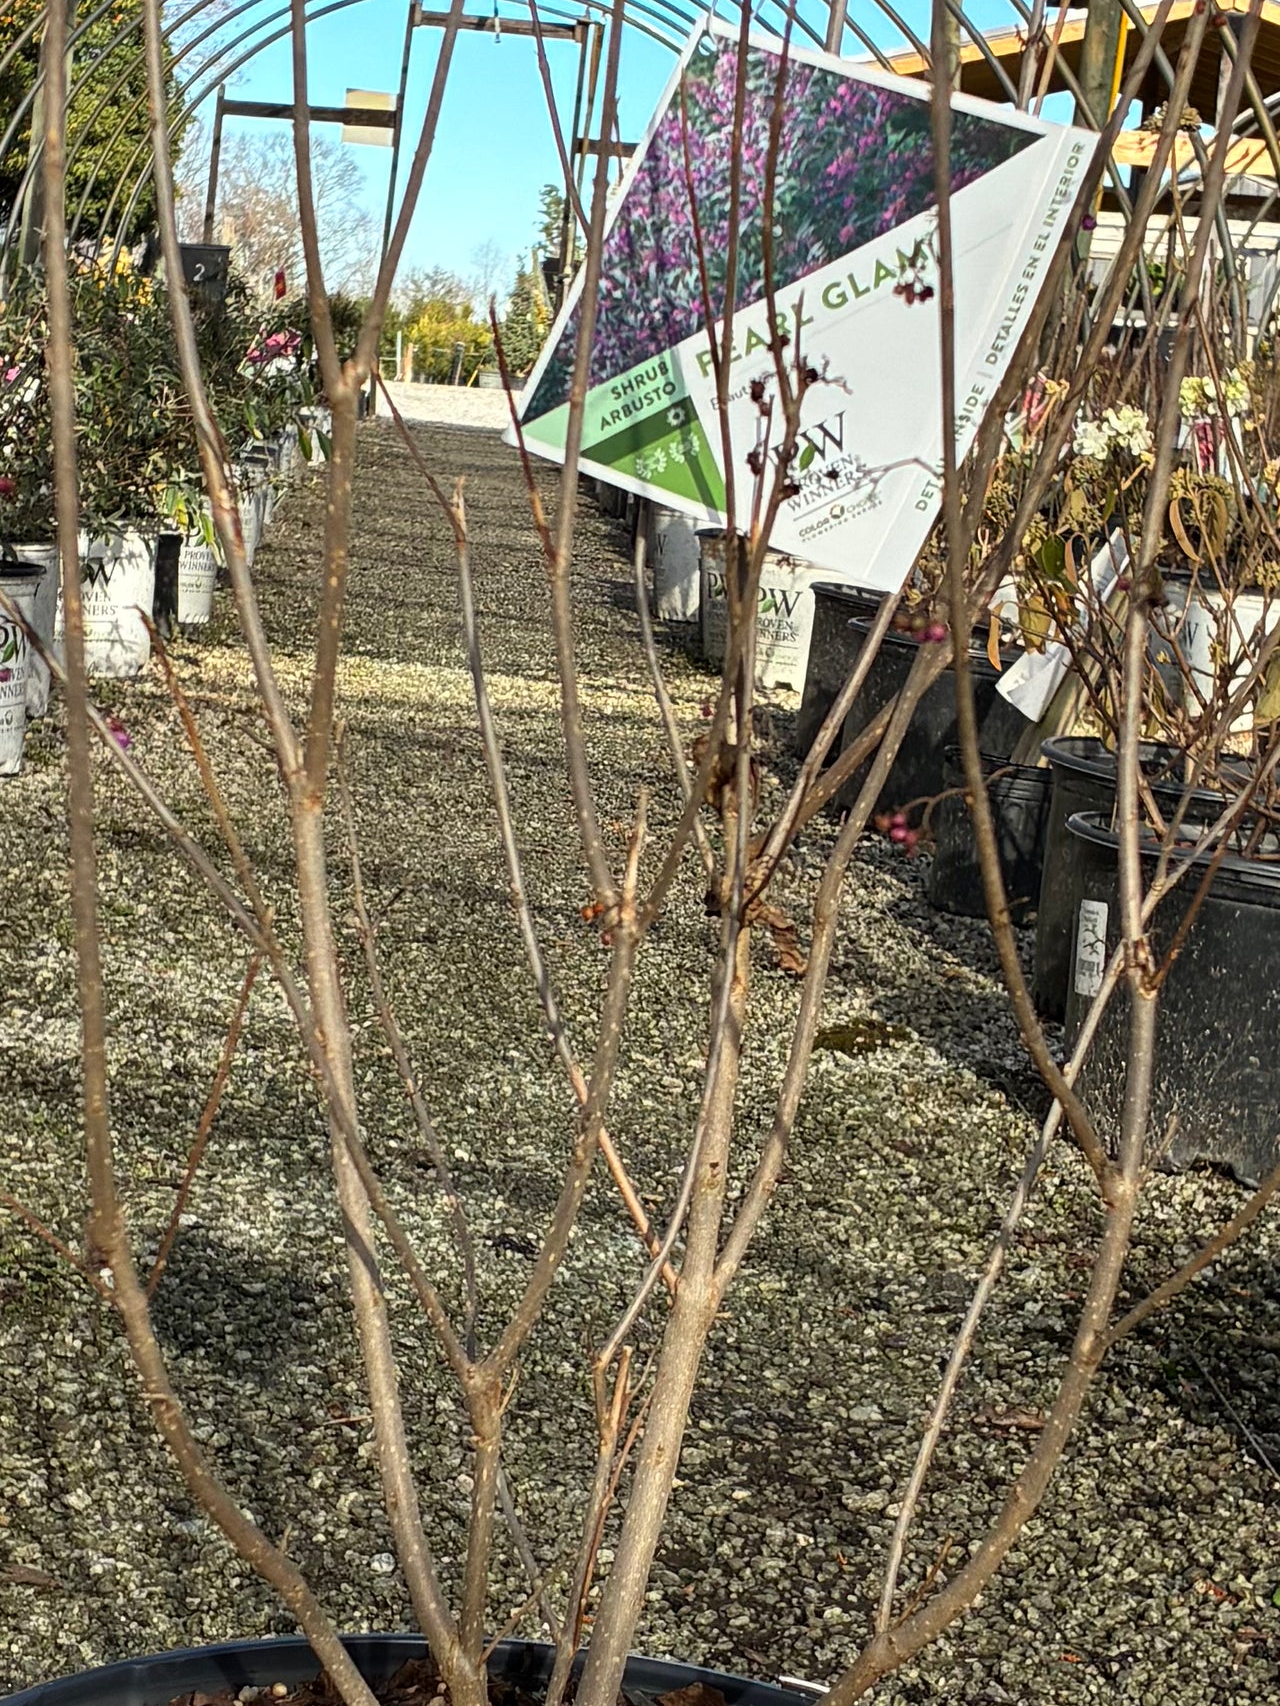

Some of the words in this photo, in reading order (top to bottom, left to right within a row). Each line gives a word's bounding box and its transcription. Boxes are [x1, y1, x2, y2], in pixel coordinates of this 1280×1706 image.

[193, 263, 205, 281] 2
[954, 383, 985, 441] NSIDE
[985, 282, 1029, 366] DETALLES
[1022, 256, 1040, 280] EN
[1033, 232, 1051, 252] EL
[1043, 141, 1085, 229] INTERIOR
[611, 361, 669, 400] SHRUB
[600, 381, 676, 431] ARBUSTO
